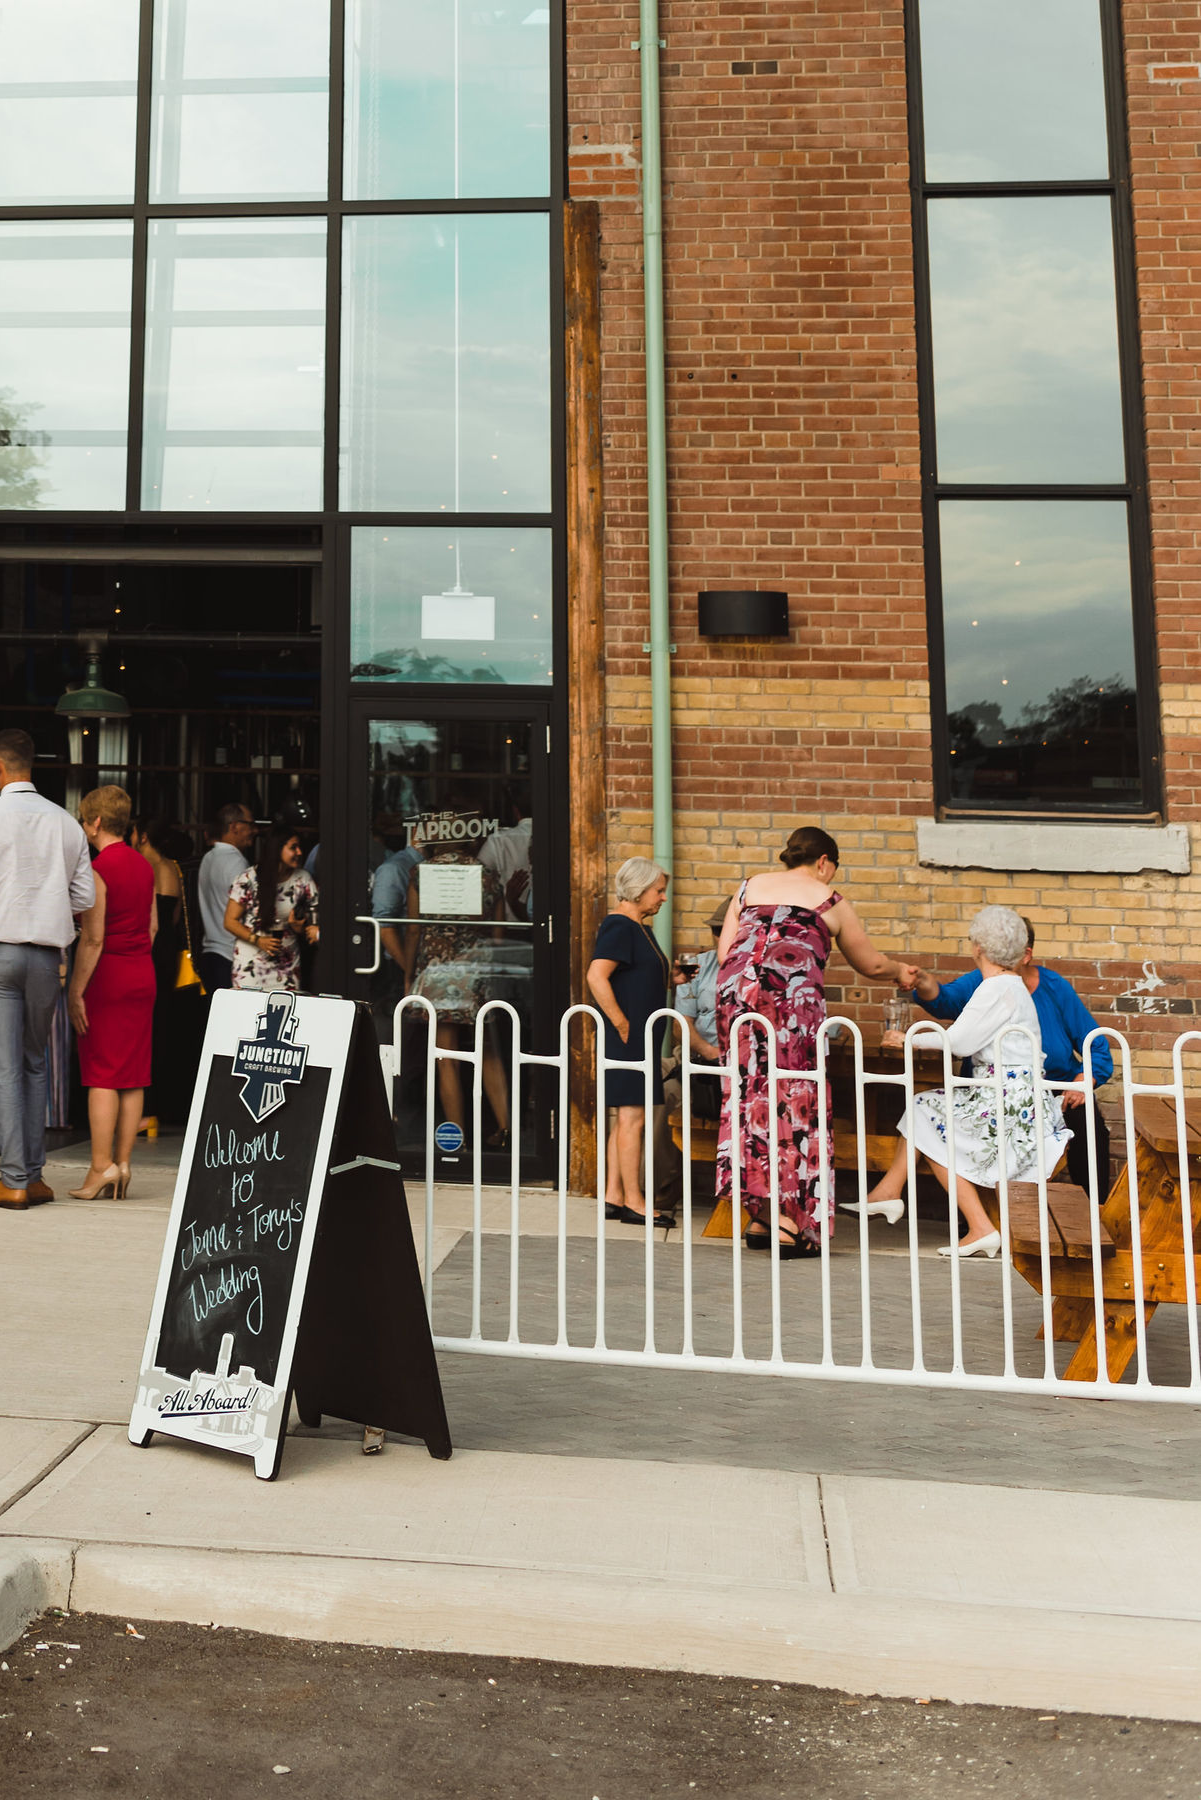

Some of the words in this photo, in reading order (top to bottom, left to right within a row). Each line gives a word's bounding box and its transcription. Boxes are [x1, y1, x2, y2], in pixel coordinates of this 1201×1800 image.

[420, 811, 454, 821] THE
[402, 818, 499, 847] TAPROOM
[239, 1044, 303, 1067] JUNCTION
[244, 1062, 264, 1072] CRAFT
[264, 1065, 292, 1075] BREWING
[204, 1123, 285, 1168] Welcome
[231, 1170, 255, 1208] to
[181, 1220, 231, 1271] Jenna
[247, 1198, 304, 1251] Tony's
[188, 1263, 265, 1335] Wedding
[158, 1388, 190, 1412] All
[187, 1386, 260, 1411] Aboard!
